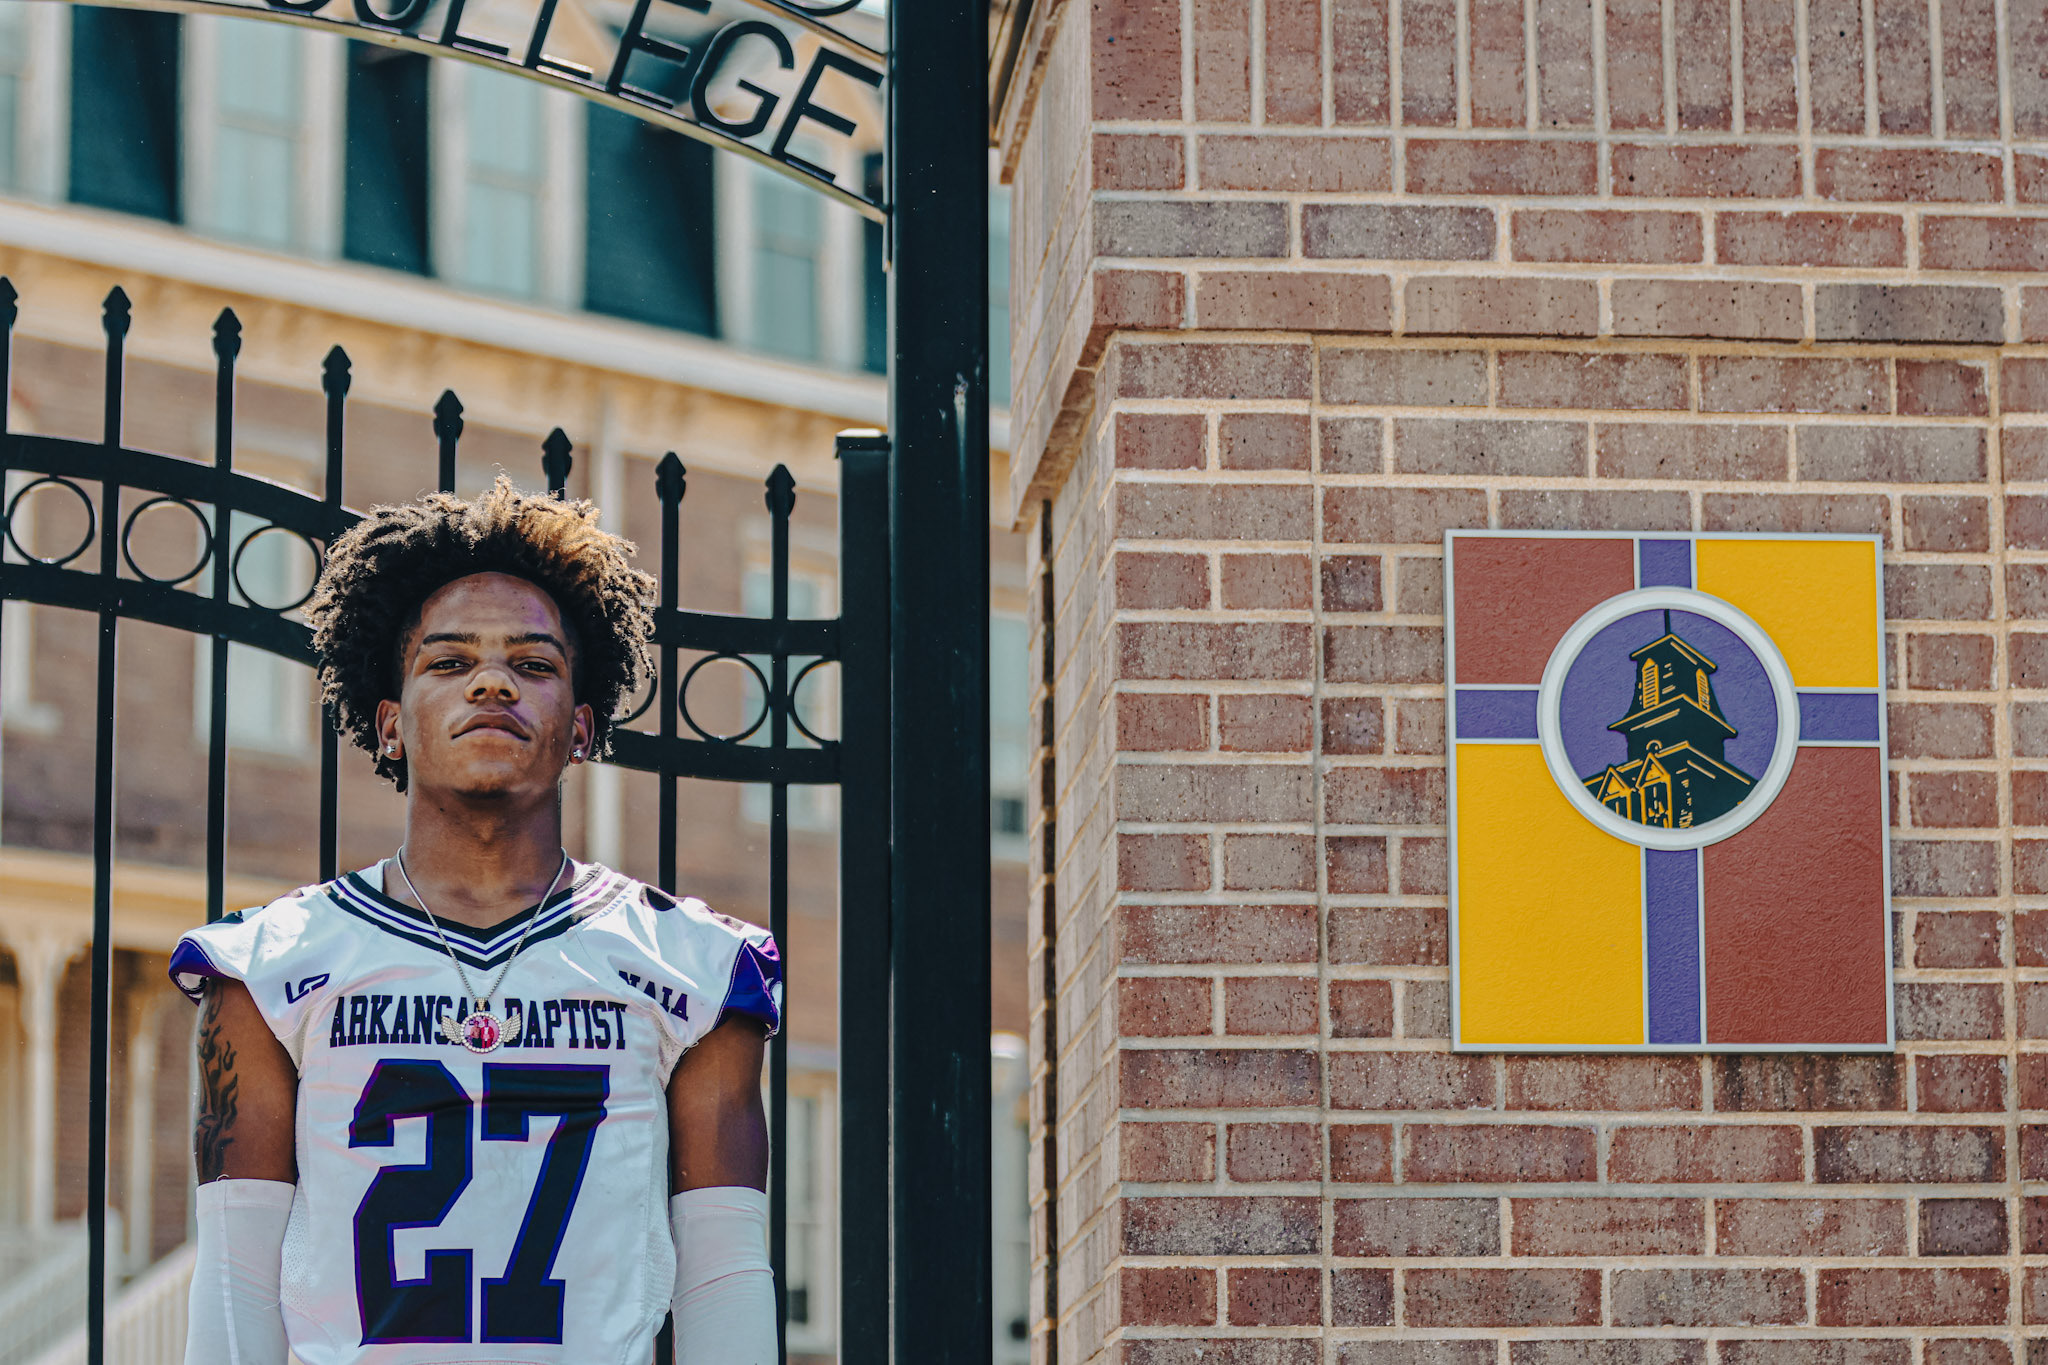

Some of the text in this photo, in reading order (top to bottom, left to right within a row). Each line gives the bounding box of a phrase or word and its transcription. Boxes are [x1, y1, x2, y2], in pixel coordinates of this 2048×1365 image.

[265, 0, 884, 183] LEGE
[330, 995, 491, 1047] ARKANSA
[348, 1058, 611, 1347] 27
